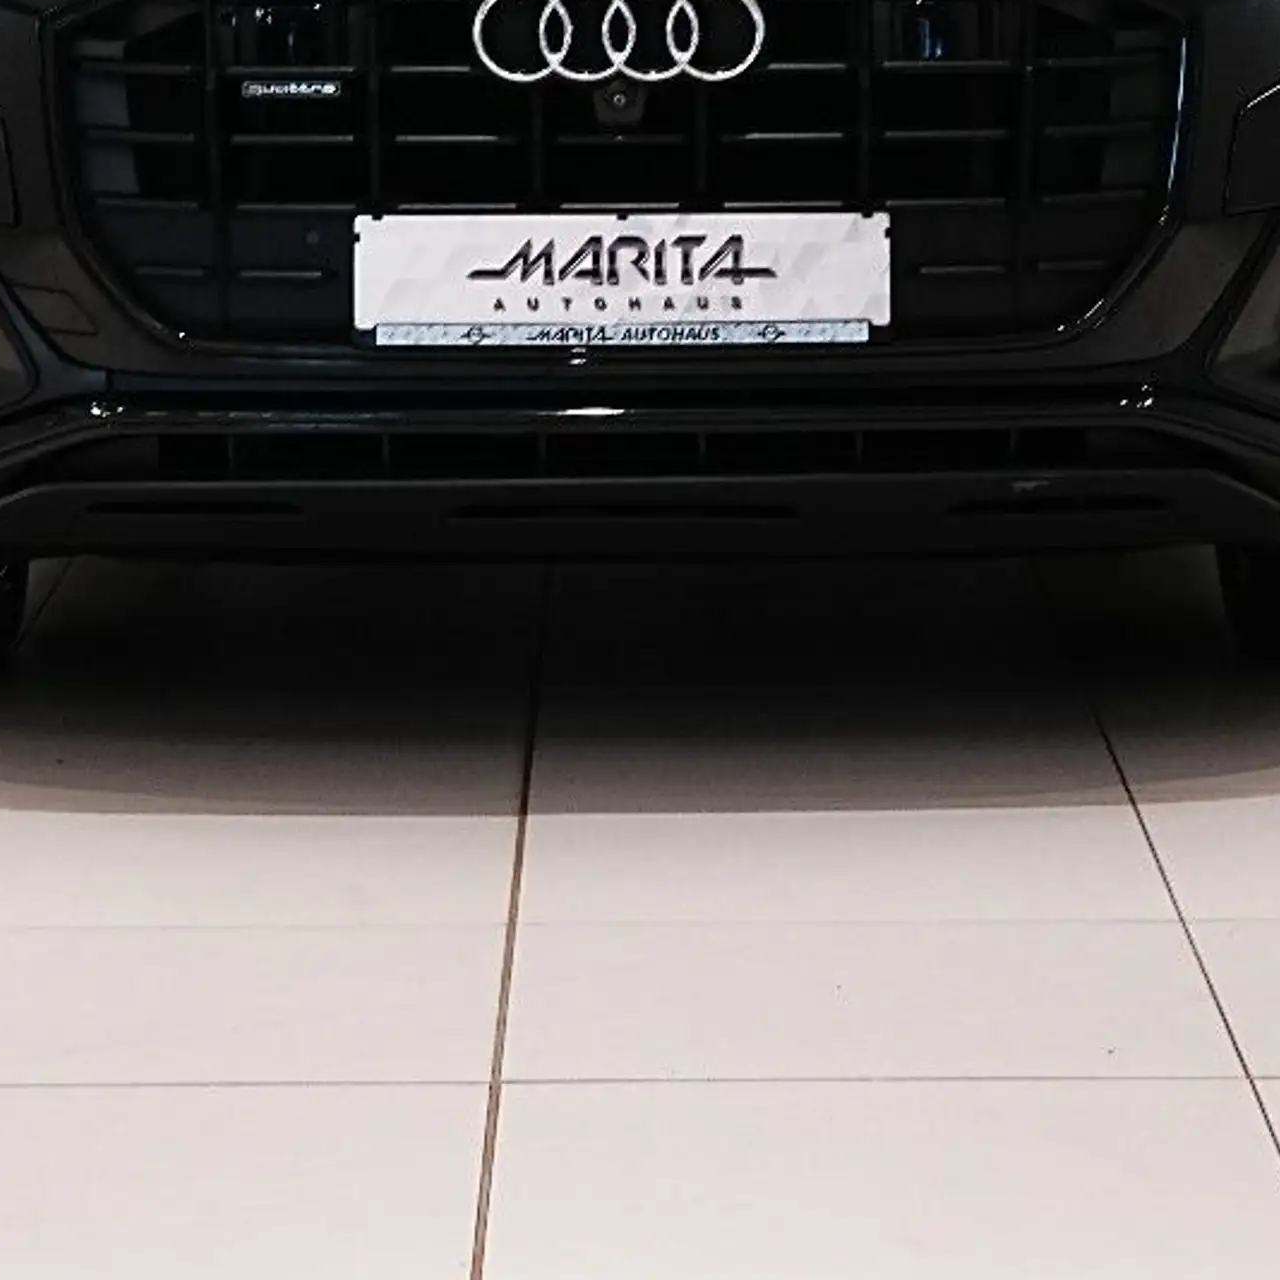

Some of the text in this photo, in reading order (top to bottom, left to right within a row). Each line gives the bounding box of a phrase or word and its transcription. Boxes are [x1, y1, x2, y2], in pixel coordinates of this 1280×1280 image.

[248, 83, 337, 96] quattro
[467, 235, 777, 286] MARITA
[494, 297, 743, 312] AUTOHAUS
[527, 327, 721, 343] MARITA AUTOHAUS
